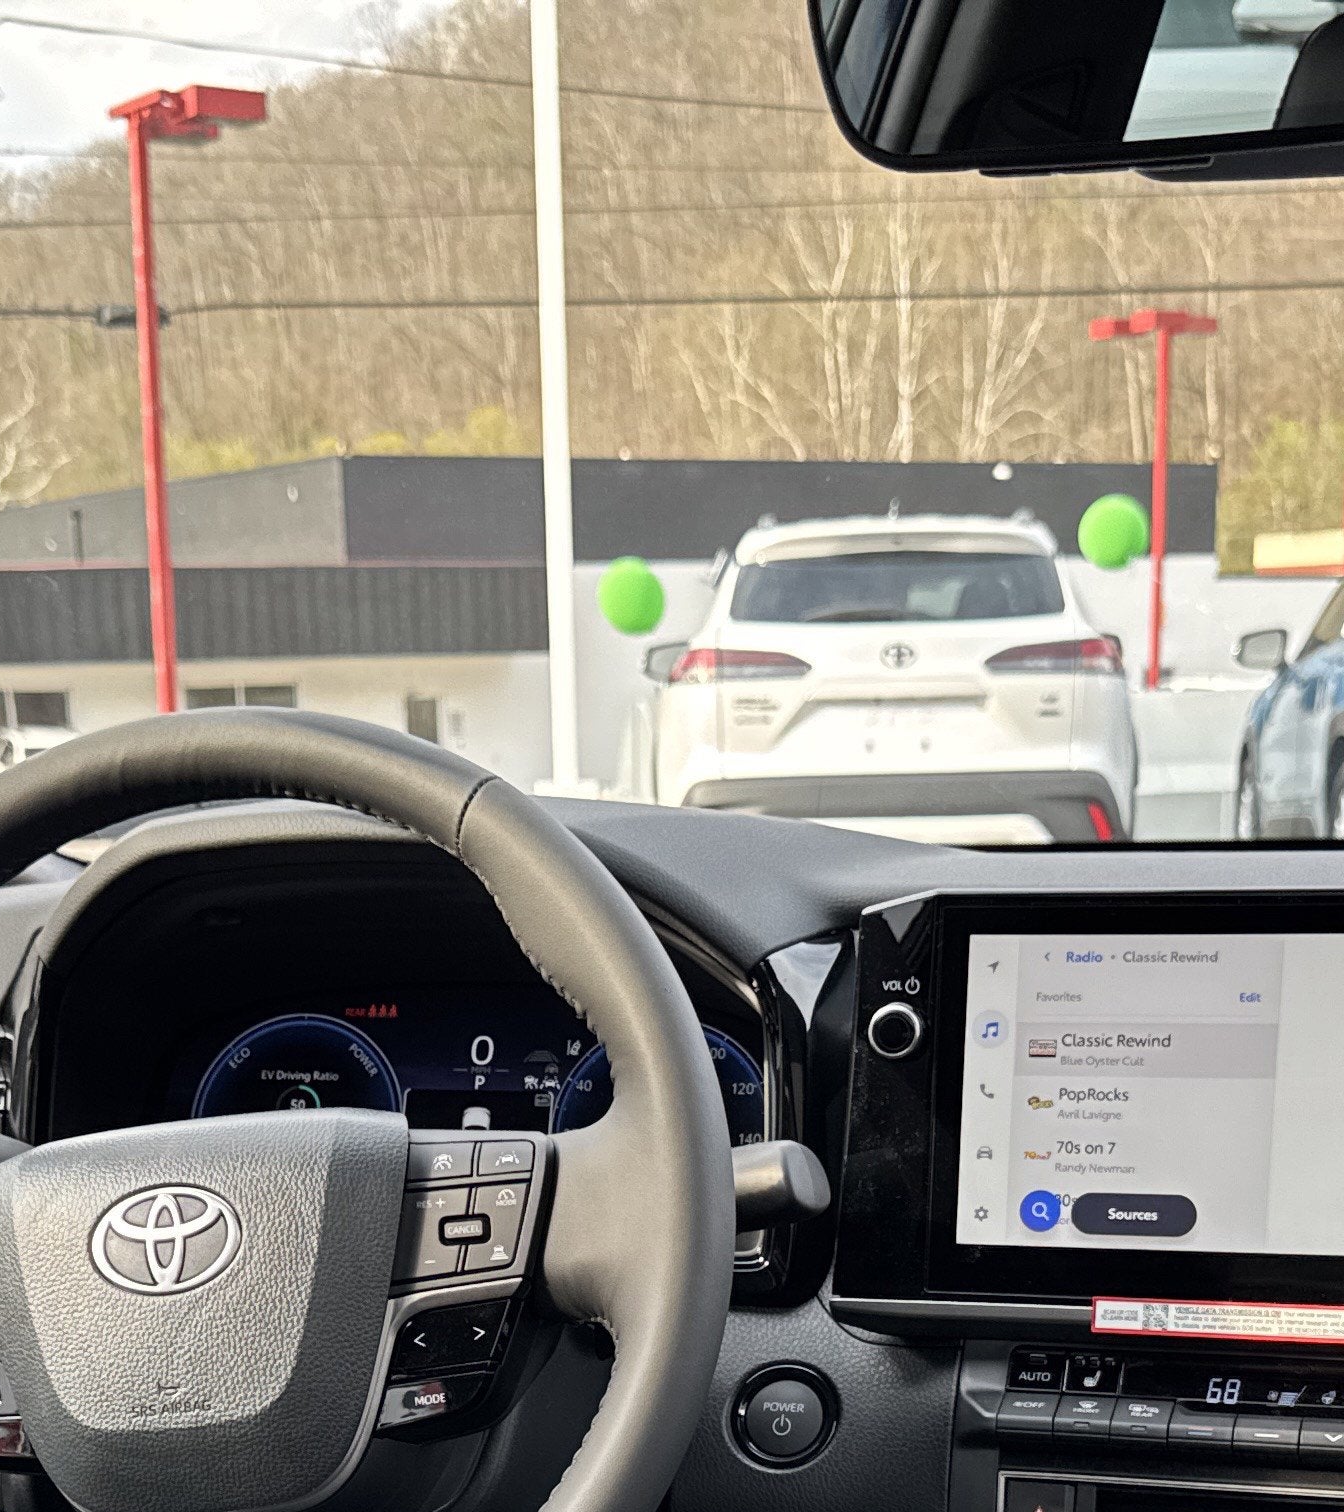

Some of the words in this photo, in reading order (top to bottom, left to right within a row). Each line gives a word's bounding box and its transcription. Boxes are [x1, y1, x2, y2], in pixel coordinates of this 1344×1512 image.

[1066, 951, 1103, 963] Radio
[1122, 951, 1168, 964] Classic
[1169, 951, 1218, 964] Rewind
[881, 979, 903, 991] VOL
[1035, 991, 1082, 1002] Favorites
[1239, 992, 1261, 1003] Edit
[1061, 1033, 1113, 1047] Classic
[1116, 1034, 1172, 1048] Rewind
[470, 1035, 494, 1066] 0
[228, 1047, 251, 1069] ECO
[348, 1043, 379, 1077] POWER
[1060, 1056, 1083, 1066] Blue
[1085, 1056, 1120, 1068] Oyster
[1122, 1056, 1144, 1066] Cult
[261, 1070, 276, 1080] EV
[276, 1070, 311, 1083] Driving
[313, 1071, 339, 1081] Ratio
[474, 1075, 486, 1090] P
[576, 1079, 593, 1092] 40
[732, 1082, 755, 1095] 120
[1059, 1087, 1129, 1104] PopRocks
[1057, 1110, 1080, 1120] Avril
[1082, 1110, 1122, 1122] Lavigne
[1056, 1141, 1081, 1155] 70s
[1084, 1143, 1104, 1155] on
[1108, 1142, 1116, 1155] 7
[1054, 1163, 1086, 1175] Randy
[1089, 1163, 1135, 1174] Newman
[1108, 1207, 1158, 1221] Sources
[447, 1225, 480, 1235] CANCEL
[1018, 1371, 1051, 1382] AUTO
[1206, 1377, 1241, 1404] 68
[414, 1392, 446, 1406] MODE
[131, 1404, 157, 1418] SRS
[161, 1399, 212, 1414] AIRBAG
[762, 1401, 805, 1413] POWER
